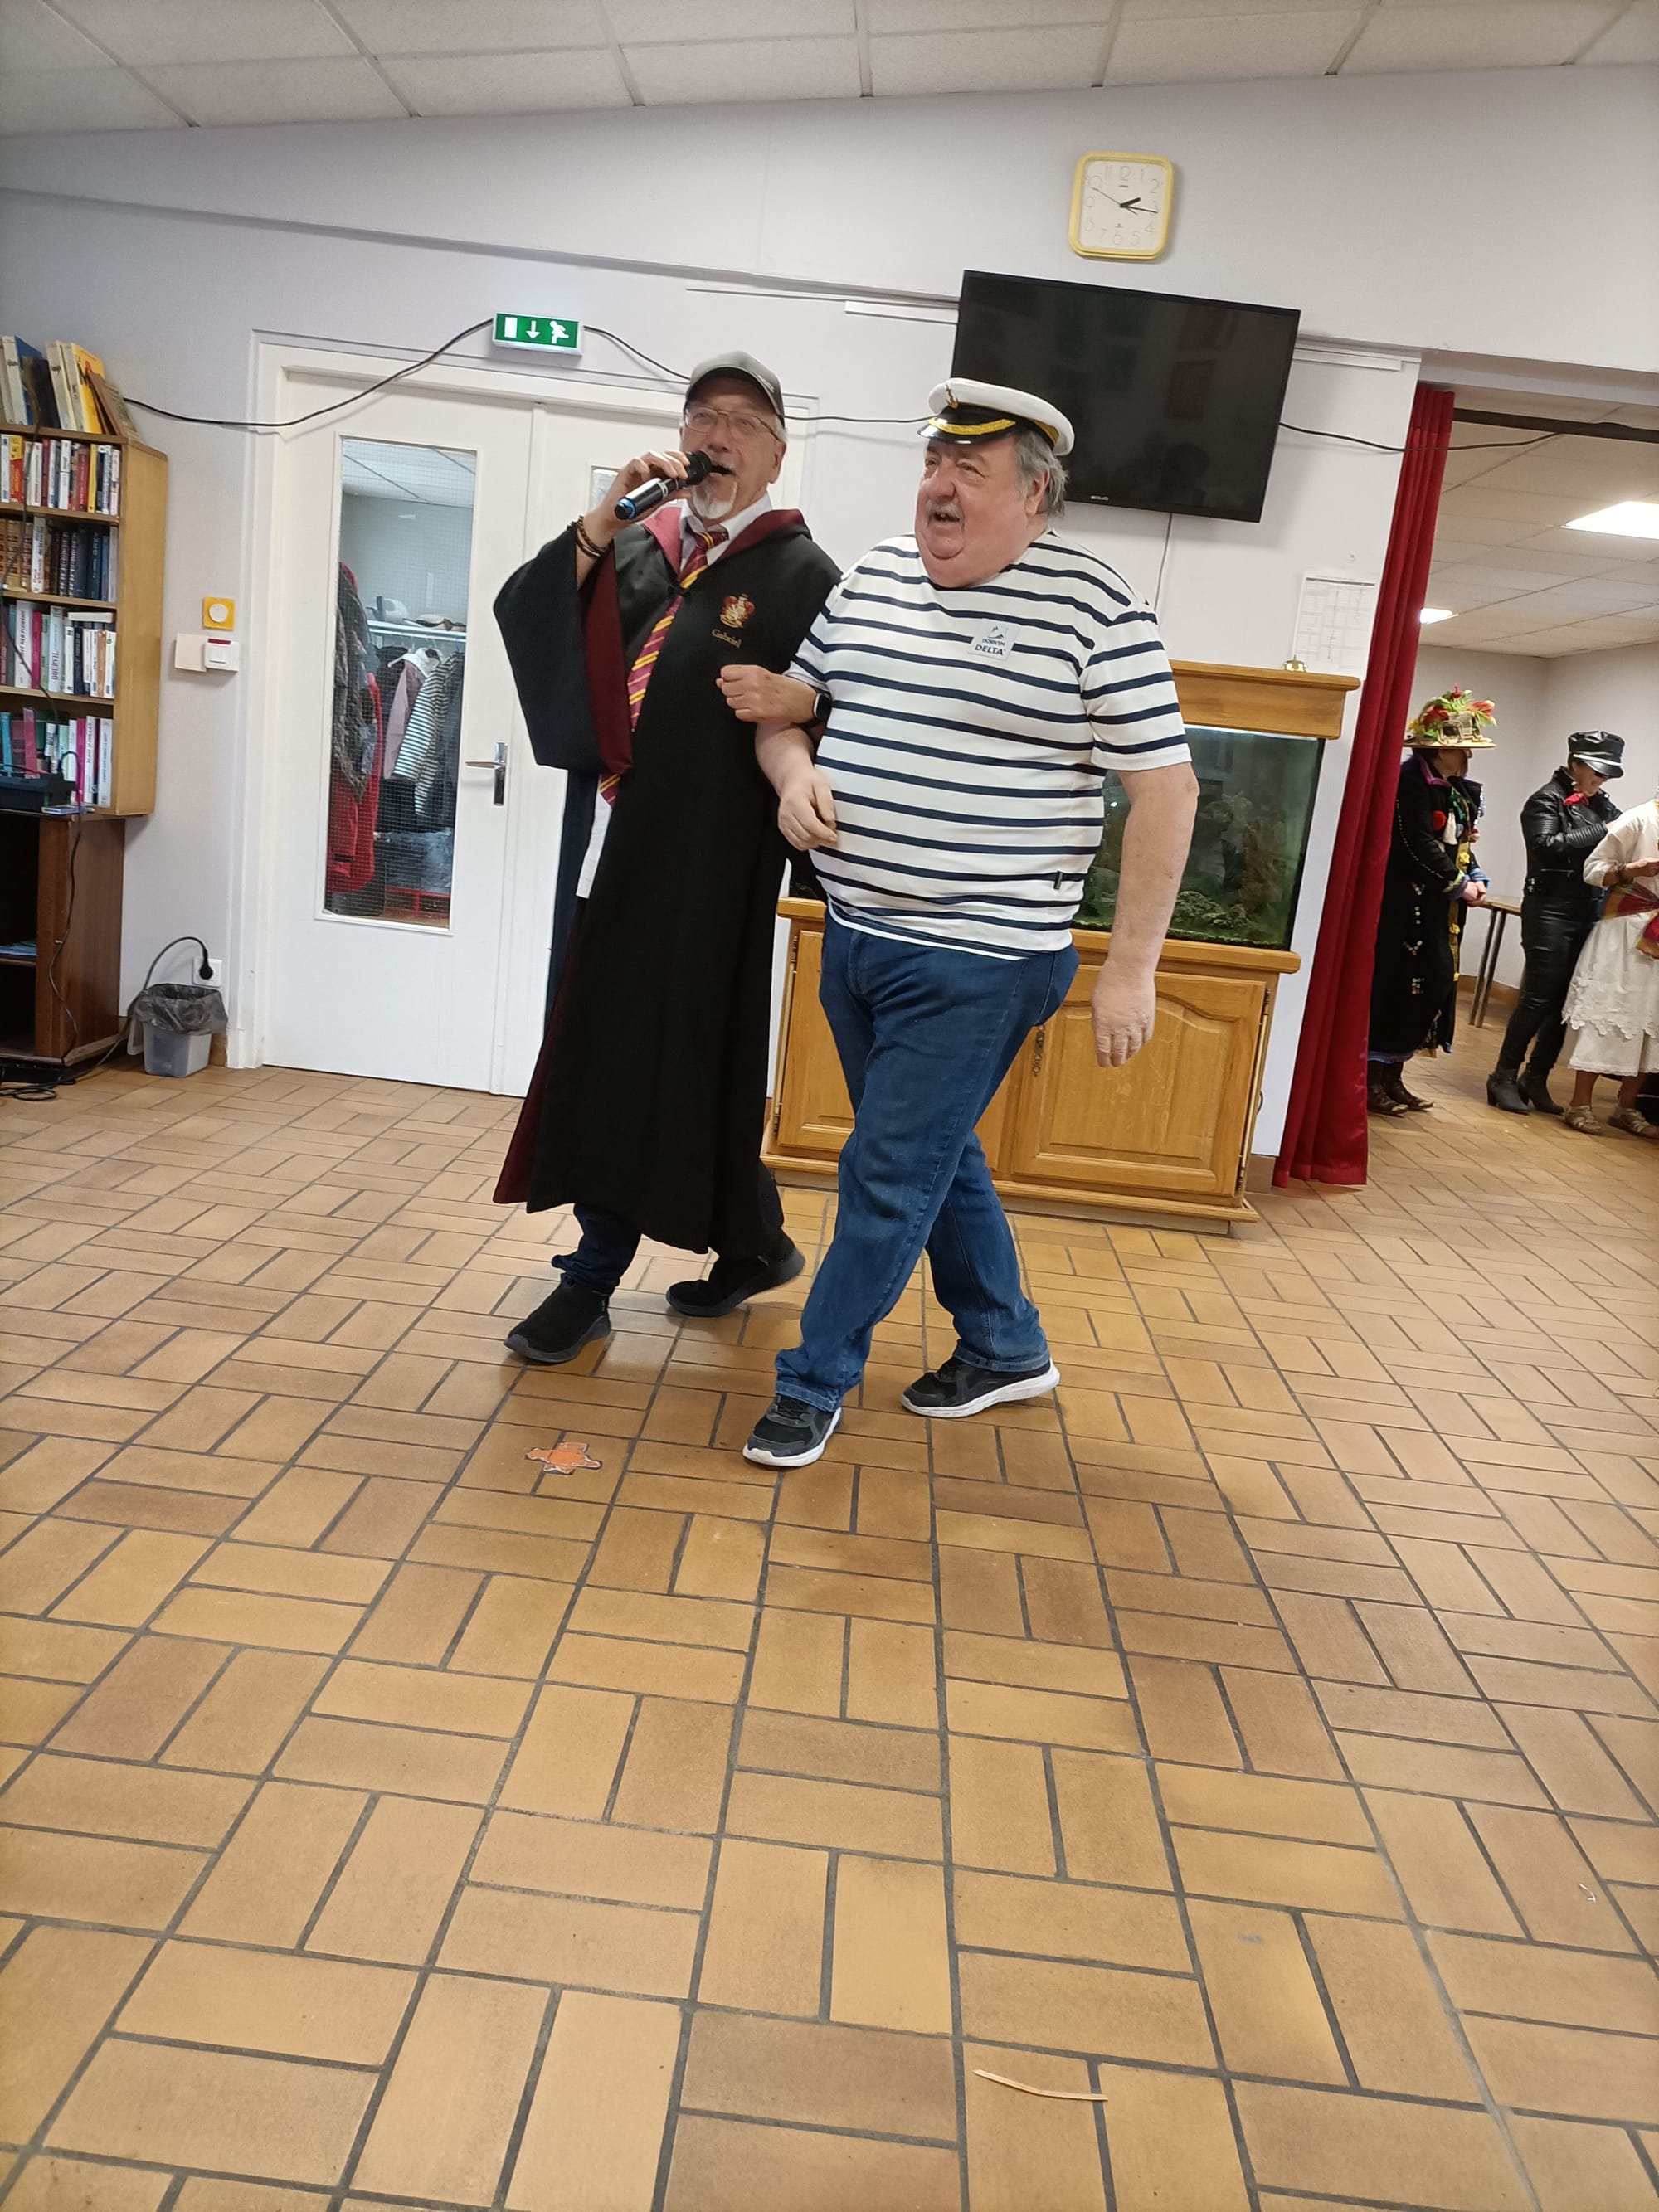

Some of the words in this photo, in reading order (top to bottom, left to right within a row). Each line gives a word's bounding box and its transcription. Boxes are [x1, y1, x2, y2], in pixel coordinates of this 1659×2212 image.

[1120, 166, 1131, 181] 12
[1150, 179, 1160, 194] 2
[1085, 196, 1095, 211] 9
[1150, 200, 1159, 216] 3
[1083, 218, 1096, 232] 8
[1145, 221, 1154, 236] 4
[1098, 228, 1107, 243] 7
[1112, 231, 1123, 246] 6
[1129, 230, 1141, 246] 5
[975, 644, 1003, 655] DELTA
